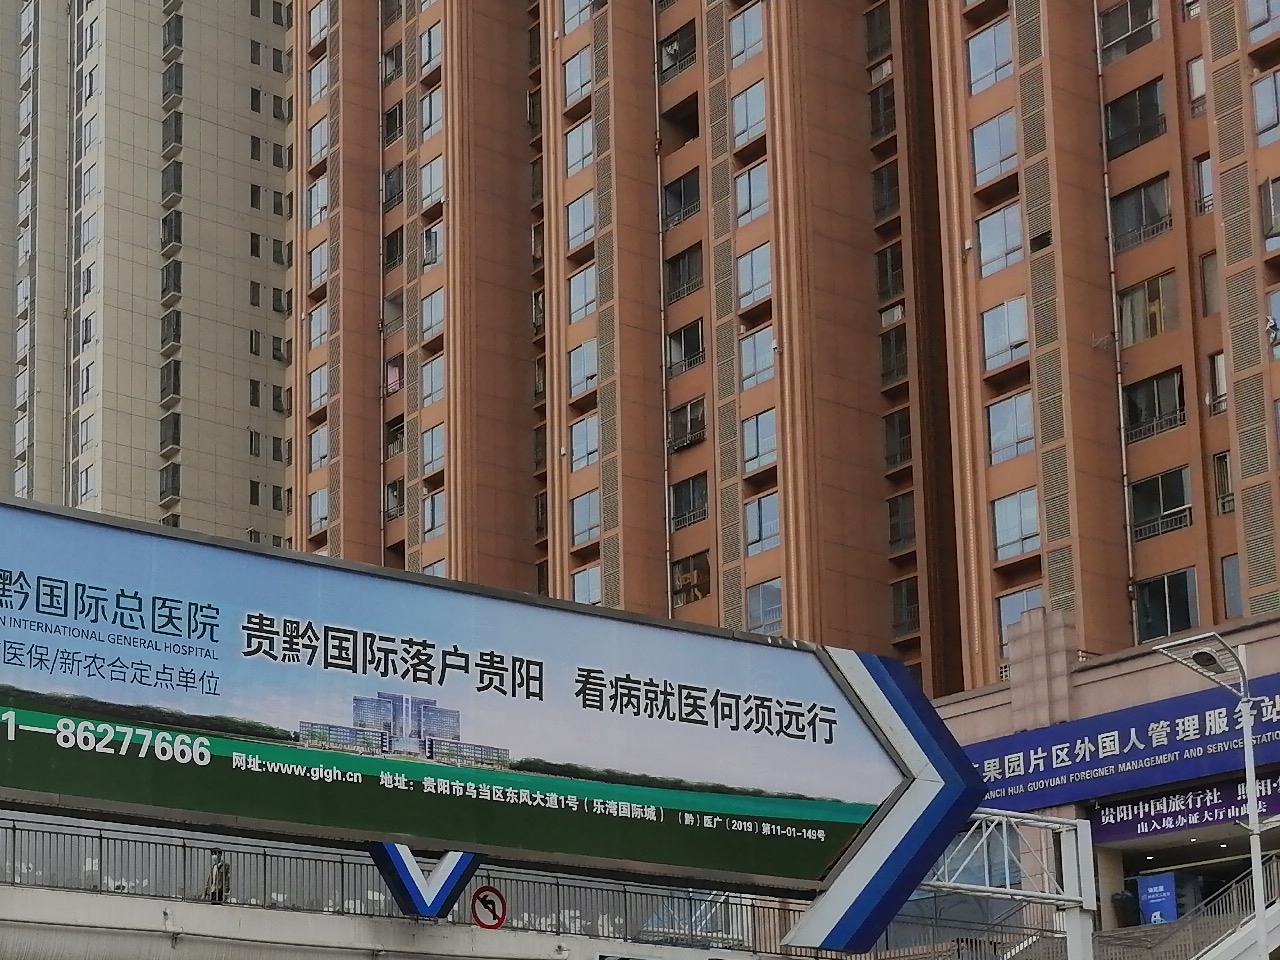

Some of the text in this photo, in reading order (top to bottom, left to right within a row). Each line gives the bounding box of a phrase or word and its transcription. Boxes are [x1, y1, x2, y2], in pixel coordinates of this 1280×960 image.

[9, 618, 105, 643] INTERNATIONAL
[107, 633, 162, 652] GENERAL
[164, 642, 219, 661] HOSPITAL
[241, 613, 838, 744] 贵黔国际落户贵阳 看病就医何须远行
[972, 694, 1280, 783] 果园片区外国人管理服务站
[982, 787, 1006, 801] ANCH
[1008, 784, 1025, 797] HUA
[1027, 775, 1068, 792] GUOYUAN
[1070, 765, 1116, 783] FOREIGNER
[1118, 751, 1181, 773] MANAGEMENT
[1183, 746, 1204, 760] AND
[1206, 737, 1244, 754] SERVICE
[1100, 787, 1223, 825] 贵阳中国旅行社
